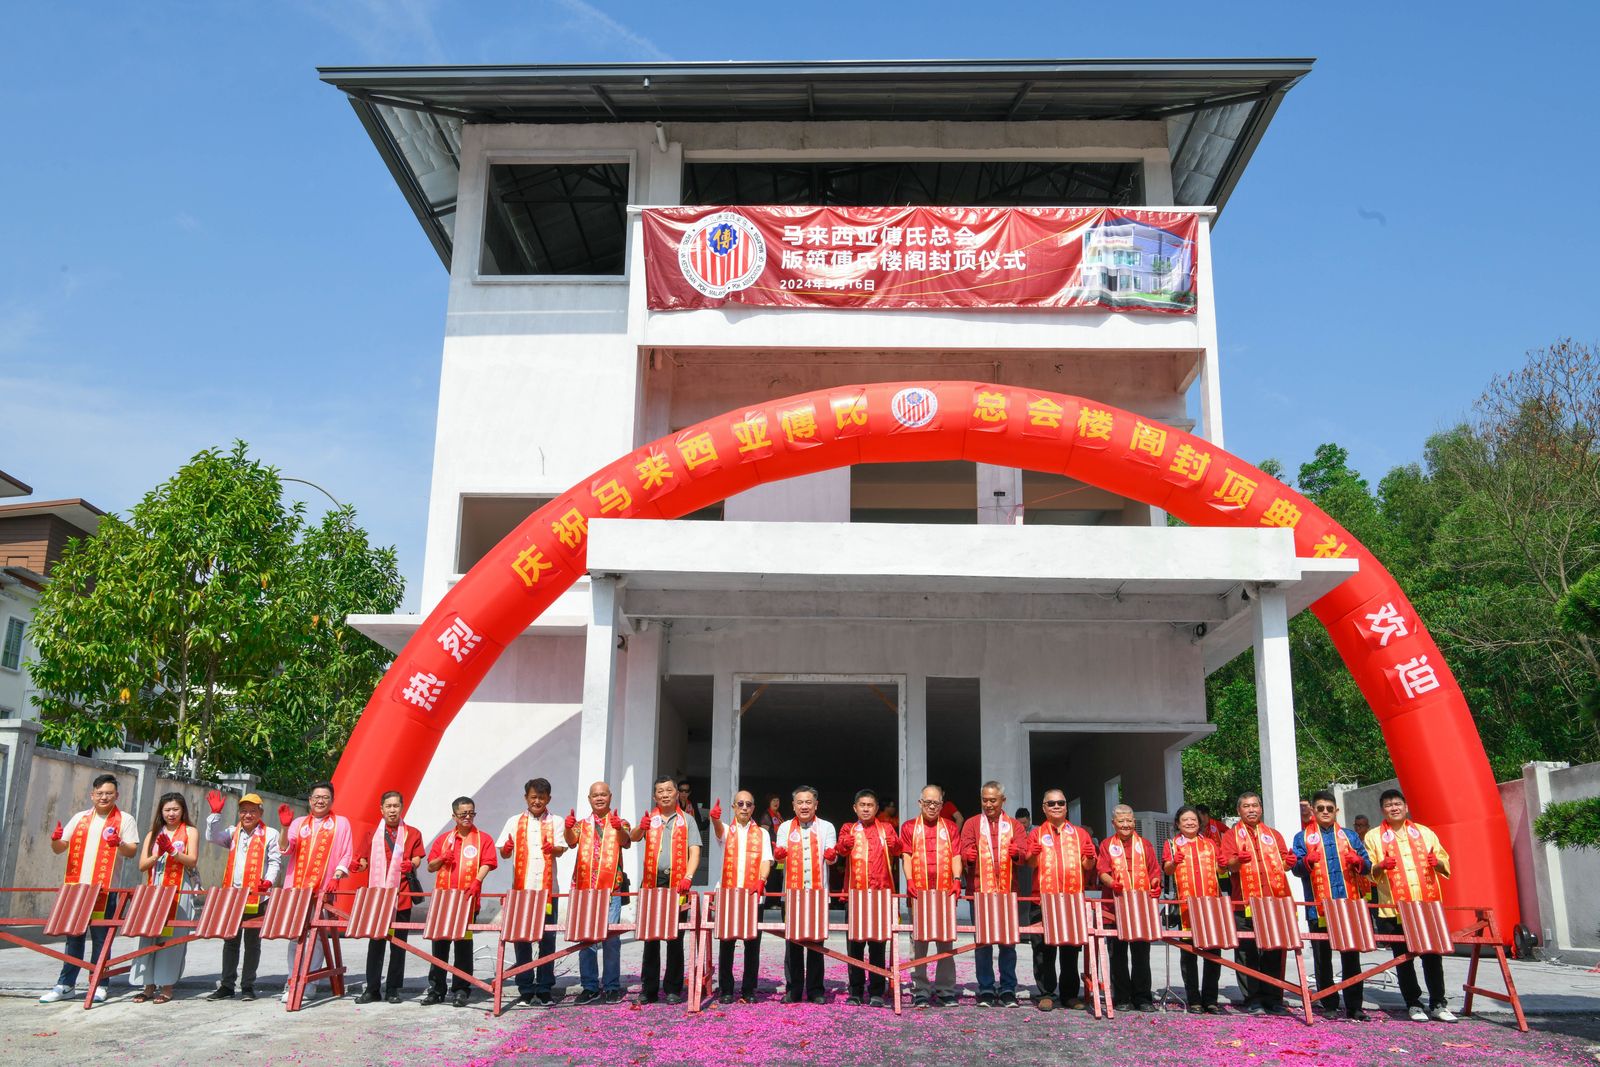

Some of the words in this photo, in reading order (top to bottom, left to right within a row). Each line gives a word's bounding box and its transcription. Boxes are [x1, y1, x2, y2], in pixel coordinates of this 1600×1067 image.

[781, 225, 976, 247] 马来西亚傅氏总会
[781, 249, 1027, 272] 版筑傅氏楼阁封顶仪式
[402, 617, 482, 711] 热烈
[1365, 602, 1441, 699] 欢迎
